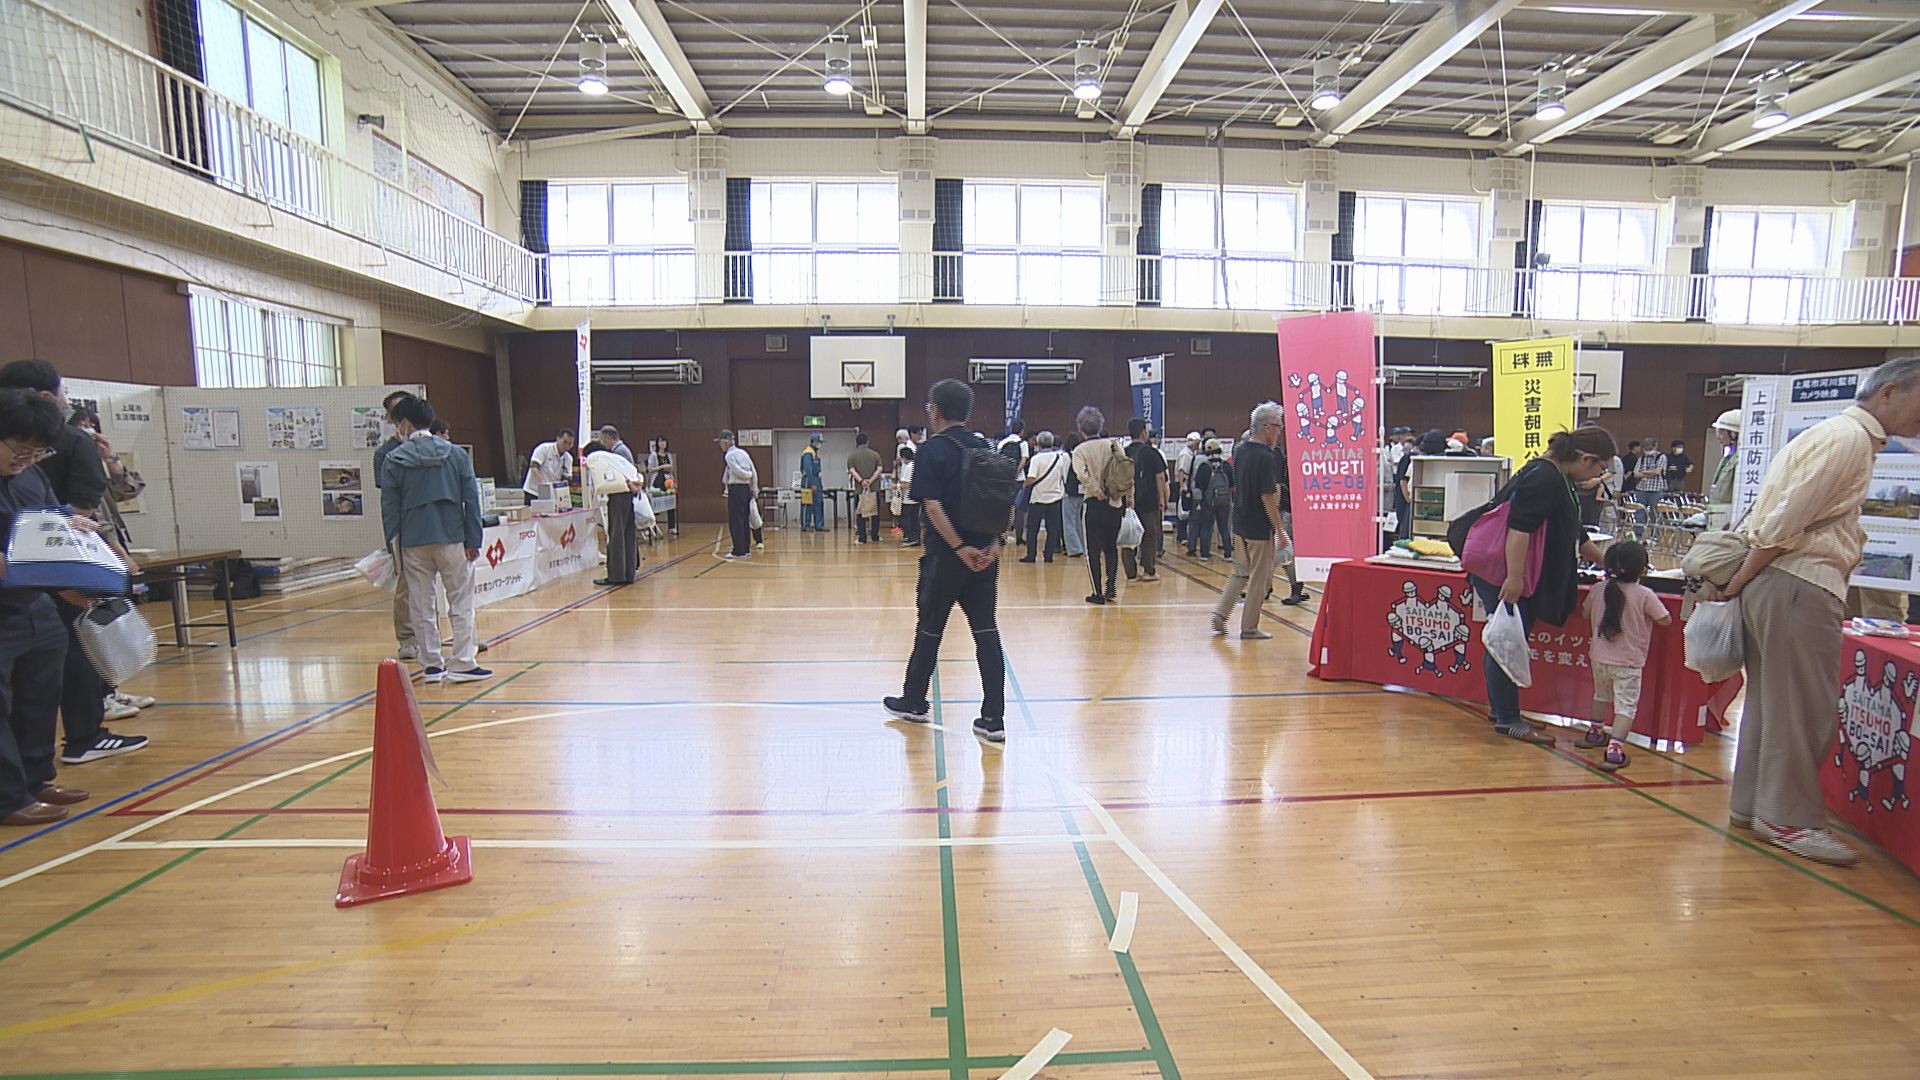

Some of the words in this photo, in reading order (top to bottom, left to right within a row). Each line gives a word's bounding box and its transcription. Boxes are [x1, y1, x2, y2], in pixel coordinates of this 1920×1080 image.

[1794, 376, 1857, 389] 上尾市河川監視
[1800, 388, 1839, 400] カメラ映像
[1742, 390, 1768, 513] 上尾市防災士
[1405, 606, 1451, 621] SAITAMA
[1405, 616, 1450, 630] ITSUMO
[1406, 625, 1451, 641] BO-SAI
[1852, 691, 1893, 719] SAITAMA
[1850, 703, 1891, 736] ITSUMO
[1849, 720, 1889, 756] BO-SAI
